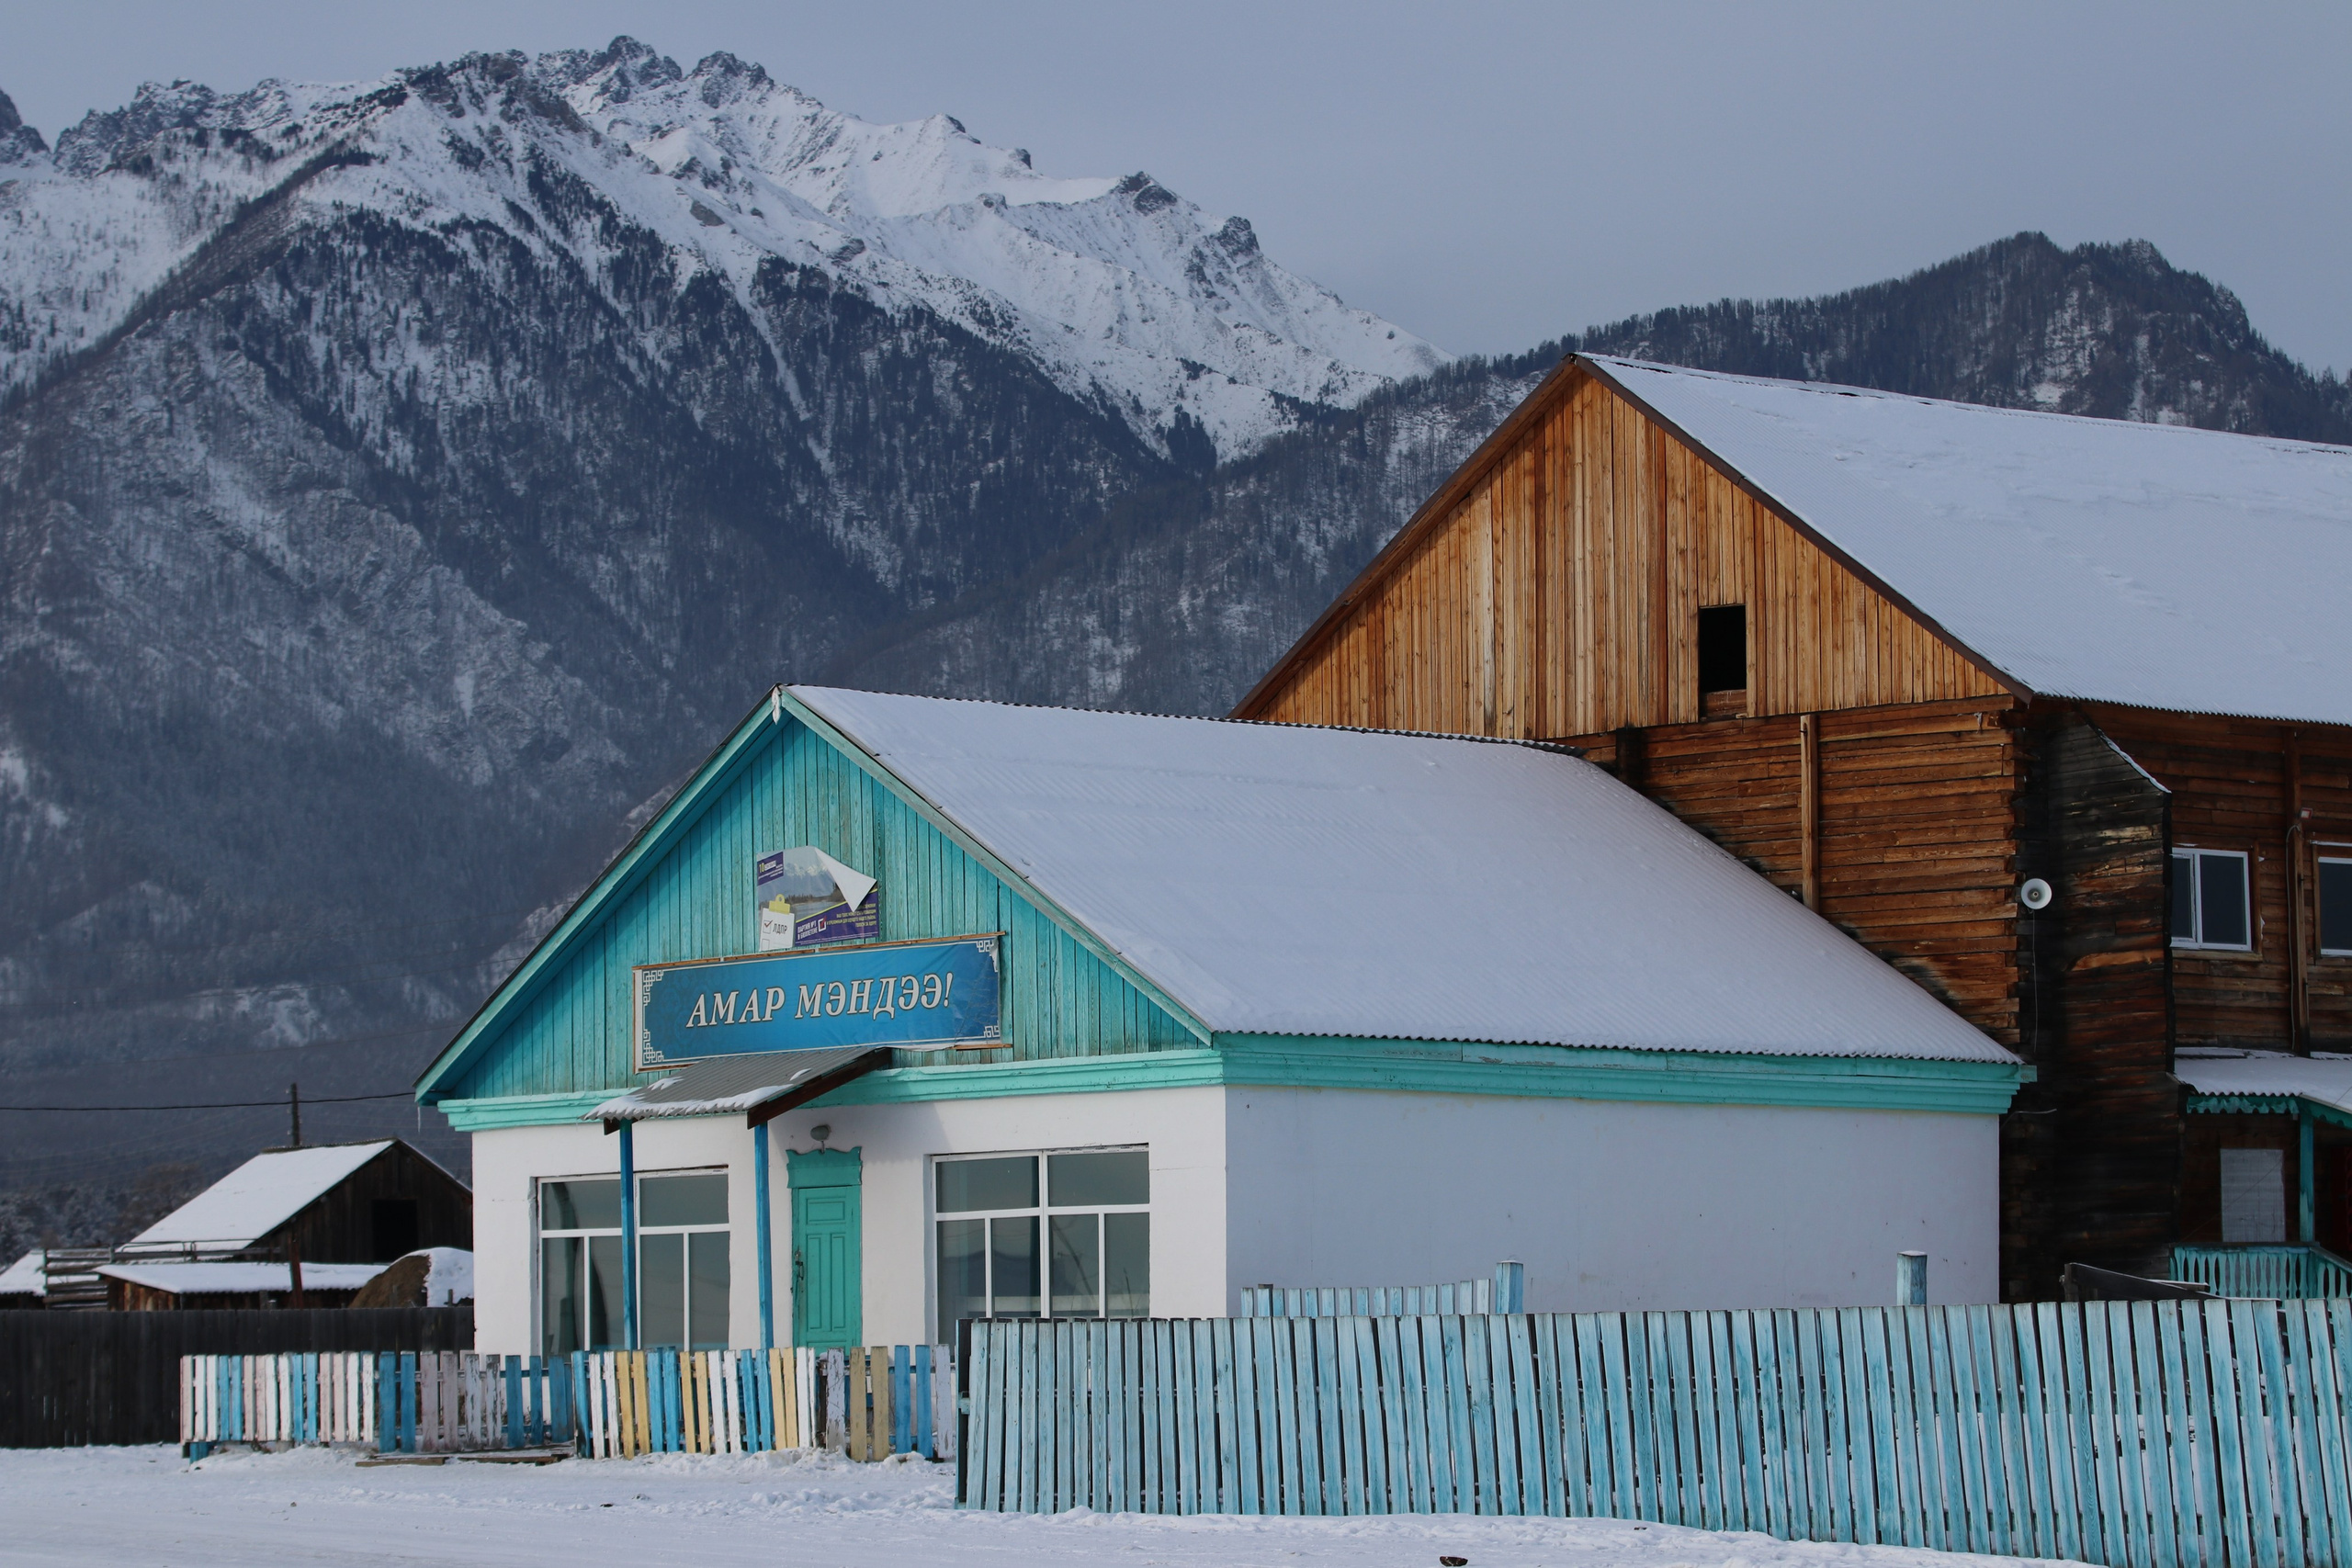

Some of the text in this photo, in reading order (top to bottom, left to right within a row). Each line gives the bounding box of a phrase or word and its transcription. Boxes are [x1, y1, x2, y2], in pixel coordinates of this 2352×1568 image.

[772, 923, 788, 935] ЛДПР
[685, 972, 954, 1028] АМАР МЭНДЭЭ!
